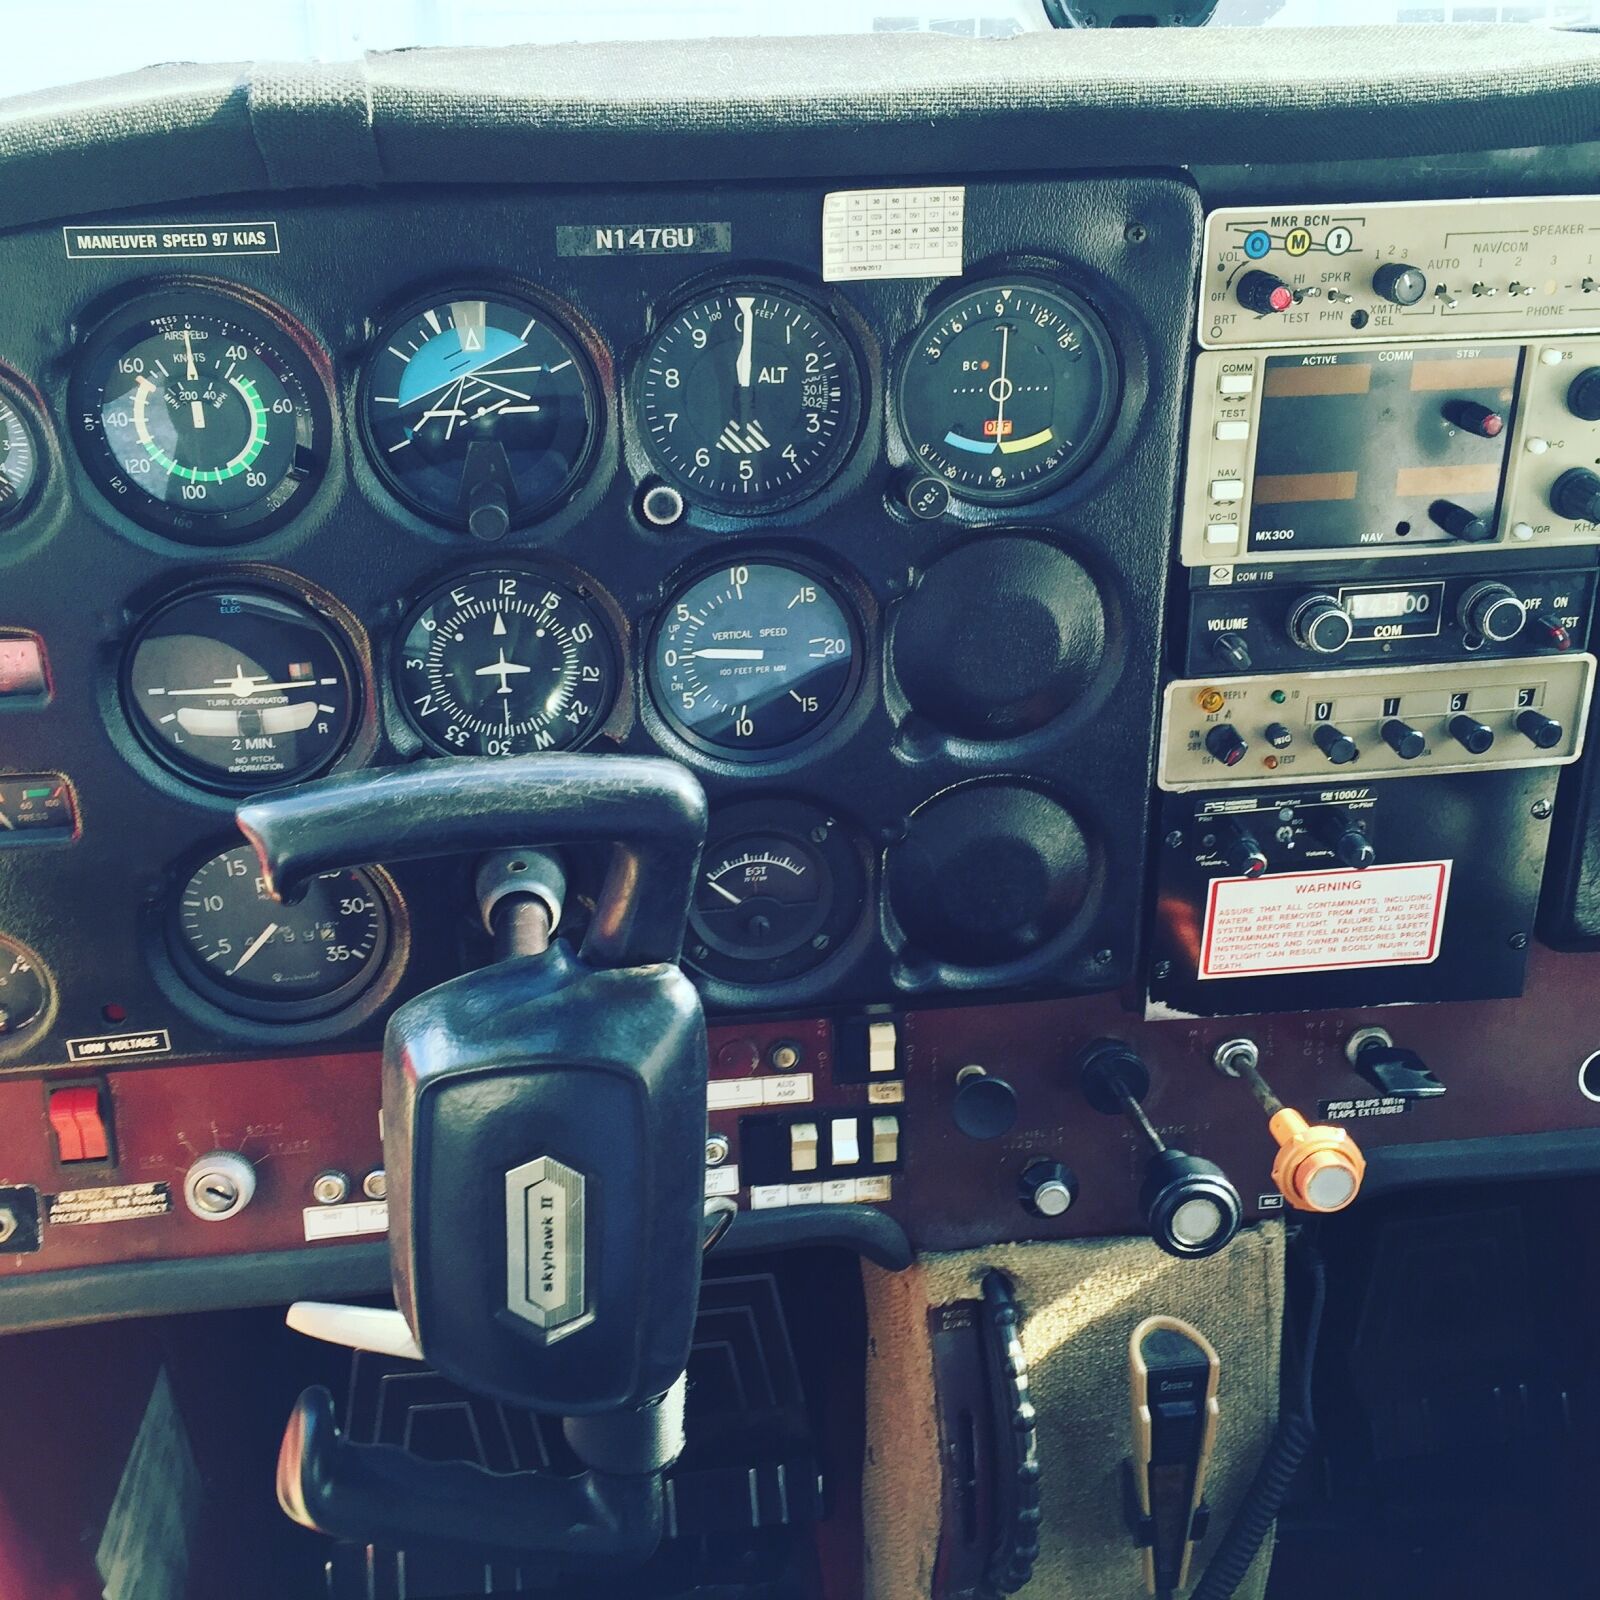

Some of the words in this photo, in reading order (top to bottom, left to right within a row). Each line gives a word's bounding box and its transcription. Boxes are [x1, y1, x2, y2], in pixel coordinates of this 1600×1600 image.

[1271, 217, 1298, 227] MKR
[1304, 215, 1330, 226] BCN
[1532, 224, 1584, 236] SPEAKER
[76, 234, 157, 250] MANEUVER
[162, 232, 207, 248] SPEED
[212, 232, 228, 246] 97
[233, 231, 266, 246] KIAS
[596, 228, 694, 249] N1476U
[1473, 242, 1528, 253] NAV/COM
[1219, 251, 1240, 261] VOL
[1428, 258, 1460, 269] AUTO
[1294, 274, 1305, 284] HI
[1321, 272, 1351, 282] SPKR
[755, 309, 774, 320] FEET
[995, 303, 1004, 316] 9
[1370, 304, 1403, 314] XMTR
[1526, 305, 1565, 316] PHONE
[151, 316, 178, 326] PRESS
[708, 312, 722, 322] 100
[1214, 314, 1237, 324] BRT
[1282, 312, 1309, 323] TEST
[1320, 311, 1343, 320] PHN
[1374, 316, 1394, 326] SEL
[164, 330, 208, 340] AIRSEED
[691, 329, 707, 349] 9
[225, 345, 248, 361] 40
[1302, 355, 1337, 365] ACTIVE
[1380, 351, 1413, 361] COMM
[1456, 350, 1480, 358] STBY
[118, 357, 144, 374] 160
[805, 353, 819, 373] 2
[962, 361, 978, 371] BC
[1222, 364, 1253, 372] COMM
[665, 369, 680, 388] 8
[758, 367, 789, 384] ALT
[179, 391, 198, 401] 200
[203, 391, 217, 400] 40
[803, 384, 822, 395] 30.1
[163, 393, 180, 410] MPH
[272, 399, 293, 413] 60
[101, 412, 128, 427] 140
[1221, 409, 1246, 417] TEST
[82, 413, 94, 431] 140
[664, 414, 679, 432] 7
[806, 414, 820, 433] 3
[695, 448, 710, 467] 6
[782, 444, 797, 462] 4
[125, 459, 151, 474] 120
[739, 460, 754, 479] 5
[1218, 469, 1237, 477] NAV
[109, 476, 128, 494] 120
[246, 472, 266, 487] 80
[182, 485, 207, 499] 100
[1256, 529, 1294, 541] MX300
[1360, 533, 1384, 542] NAV
[730, 566, 748, 585] 10
[1237, 572, 1256, 582] COM
[499, 579, 517, 595] 12
[451, 586, 475, 607] E
[541, 591, 562, 610] 15
[801, 587, 816, 603] 15
[1524, 598, 1542, 610] OFF
[1554, 597, 1568, 608] ON
[677, 604, 689, 622] 5
[421, 618, 436, 631] 6
[668, 625, 680, 633] UP
[1208, 618, 1248, 631] VOLUME
[1561, 617, 1579, 628] TST
[572, 623, 593, 643] S
[712, 630, 752, 640] VERTICAL
[760, 628, 787, 637] SPEED
[1374, 625, 1402, 637] COM
[825, 639, 845, 654] 20
[407, 659, 424, 670] 3
[665, 650, 677, 666] 0
[583, 666, 599, 682] 21
[734, 667, 752, 675] FEET
[671, 683, 683, 691] DN
[207, 698, 229, 707] TURN
[232, 696, 289, 705] COORDINATOR
[683, 693, 695, 709] 5
[1224, 691, 1247, 699] REPLY
[414, 695, 439, 717] N
[802, 697, 818, 712] 15
[565, 700, 588, 724] 24
[318, 723, 328, 734] R
[736, 720, 754, 736] 10
[175, 732, 184, 743] L
[444, 725, 470, 747] 33
[535, 730, 555, 750] W
[232, 739, 241, 750] 2
[488, 740, 512, 756] 30
[1280, 755, 1295, 764] TEST
[228, 763, 284, 772] INFORMATION
[226, 860, 247, 877] 15
[745, 867, 767, 876] EGT
[1296, 880, 1362, 894] WARNING
[203, 895, 224, 912] 10
[340, 898, 364, 915] 30
[1220, 907, 1253, 916] ASSURE
[1384, 894, 1432, 902] INCLUDING
[1280, 911, 1322, 920] REMOVED
[1338, 917, 1374, 925] FAILURE
[1216, 933, 1279, 943] CONTAMINANT
[1397, 922, 1429, 930] SAFETY
[218, 939, 232, 954] 5
[1215, 942, 1279, 952] INSTRUCTIONS
[1307, 940, 1338, 948] OWNER
[1344, 933, 1395, 942] ADVISORIES
[326, 945, 351, 962] 35
[1230, 951, 1260, 959] FLIGHT
[1290, 948, 1322, 956] RESULT
[1342, 943, 1372, 951] BODILY
[1378, 941, 1408, 949] INJURY
[78, 1042, 105, 1055] LOW
[108, 1036, 159, 1051] VOLTAGE
[1355, 1099, 1379, 1108] SLIPS
[1328, 1109, 1356, 1120] FLAPS
[1358, 1105, 1403, 1116] EXTENDED
[540, 1217, 553, 1292] skyhawk
